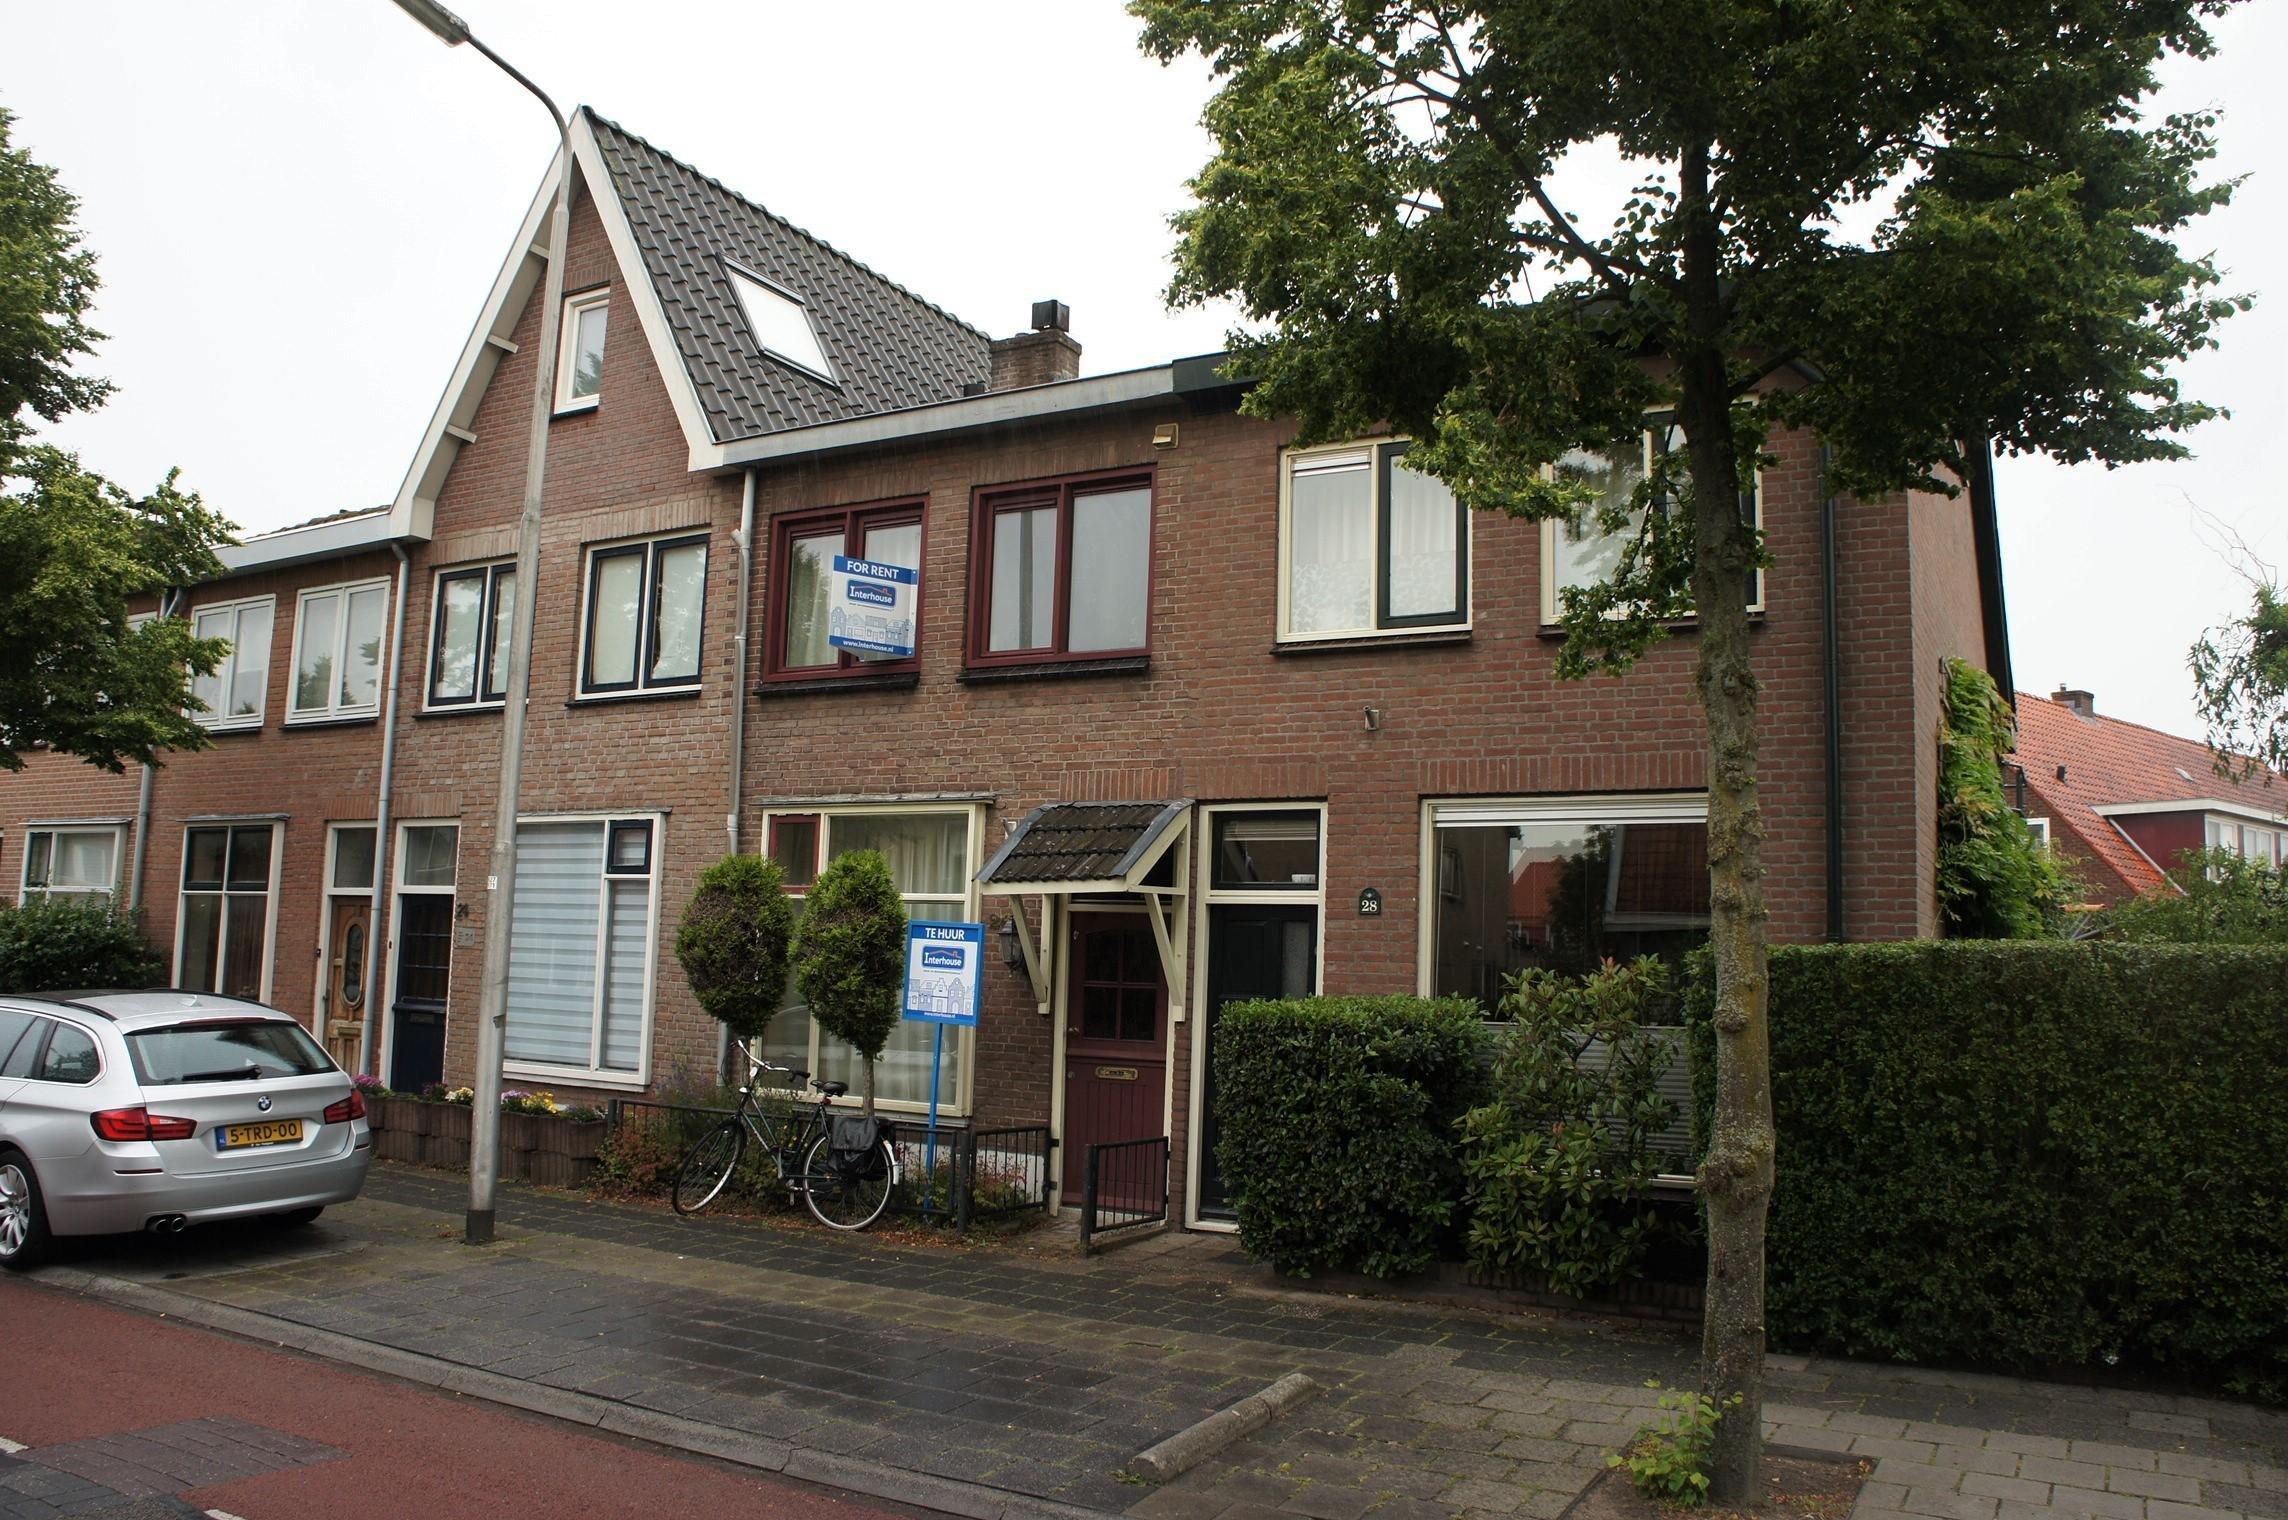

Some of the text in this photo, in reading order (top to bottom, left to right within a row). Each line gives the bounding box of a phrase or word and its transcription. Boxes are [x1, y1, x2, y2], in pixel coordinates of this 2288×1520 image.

[847, 560, 899, 579] FOR RENT
[849, 586, 893, 604] Interhouse
[1361, 899, 1377, 912] 28
[925, 927, 965, 940] TE HUUR
[924, 952, 962, 966] Interhouse
[230, 1122, 297, 1143] 5-TRD-00
